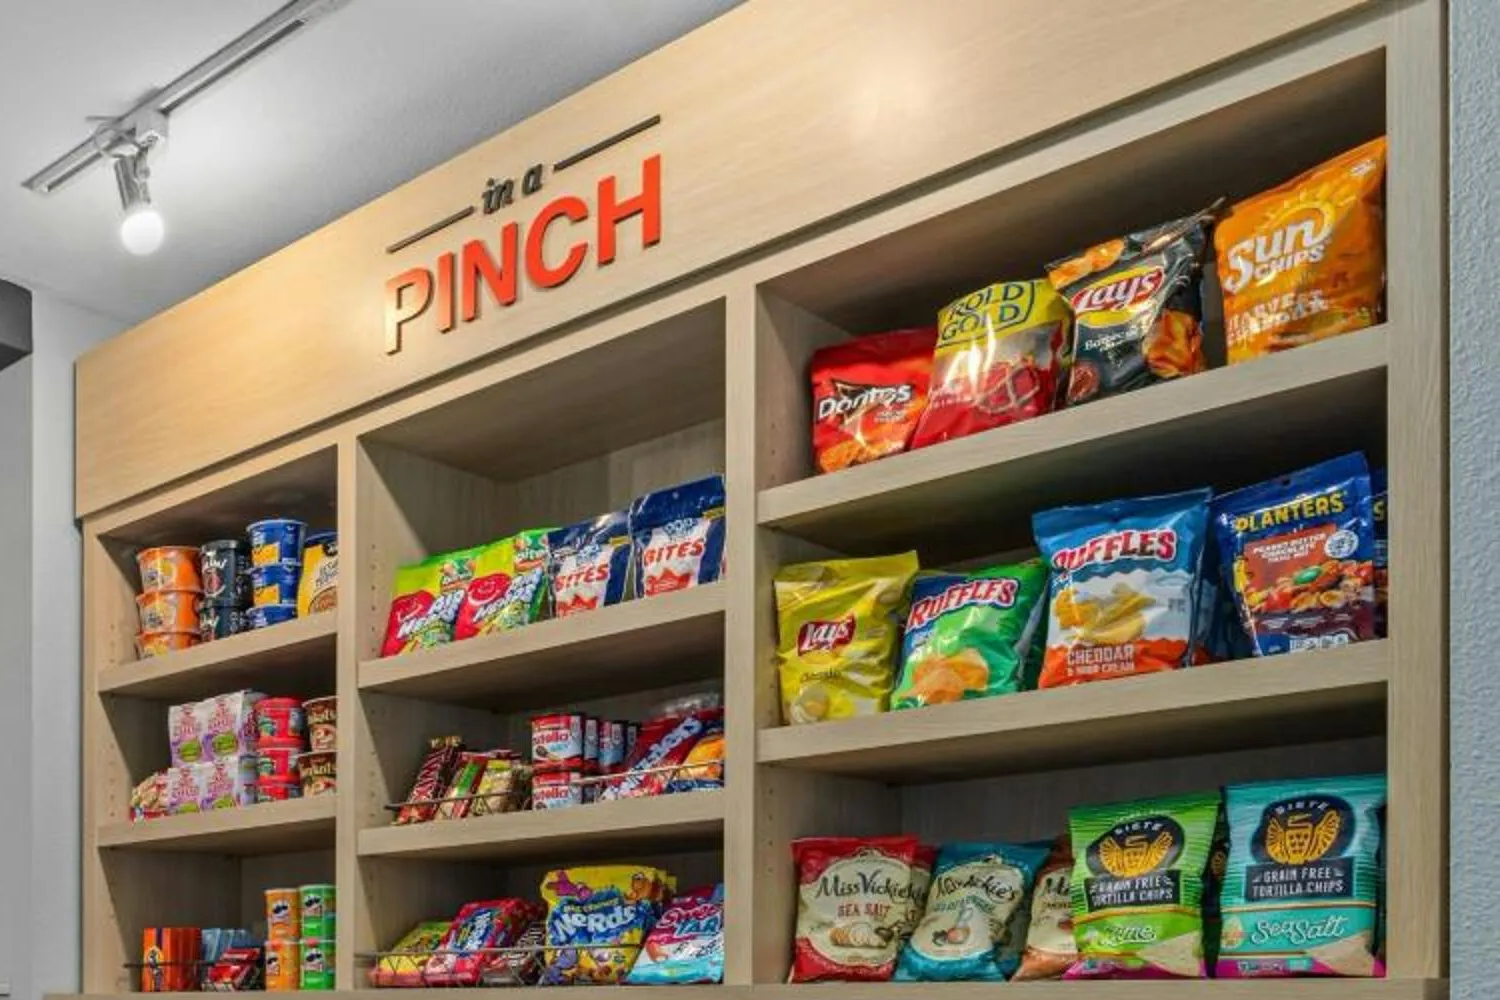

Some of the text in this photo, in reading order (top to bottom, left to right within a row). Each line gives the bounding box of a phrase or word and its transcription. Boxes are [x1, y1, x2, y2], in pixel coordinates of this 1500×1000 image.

[481, 163, 543, 215] in a
[385, 153, 661, 356] PINCH
[1223, 216, 1328, 295] Sun
[1254, 245, 1325, 279] CHIPS
[819, 385, 911, 419] Doritos
[1235, 491, 1346, 532] PLANTERS
[644, 538, 704, 566] BITES
[908, 579, 1018, 628] RUFFLES
[815, 874, 860, 899] Miss
[1252, 879, 1344, 898] TORTILLA CHIPS
[1264, 866, 1332, 884] GRAIN FREE
[1251, 915, 1349, 945] Sea Salt
